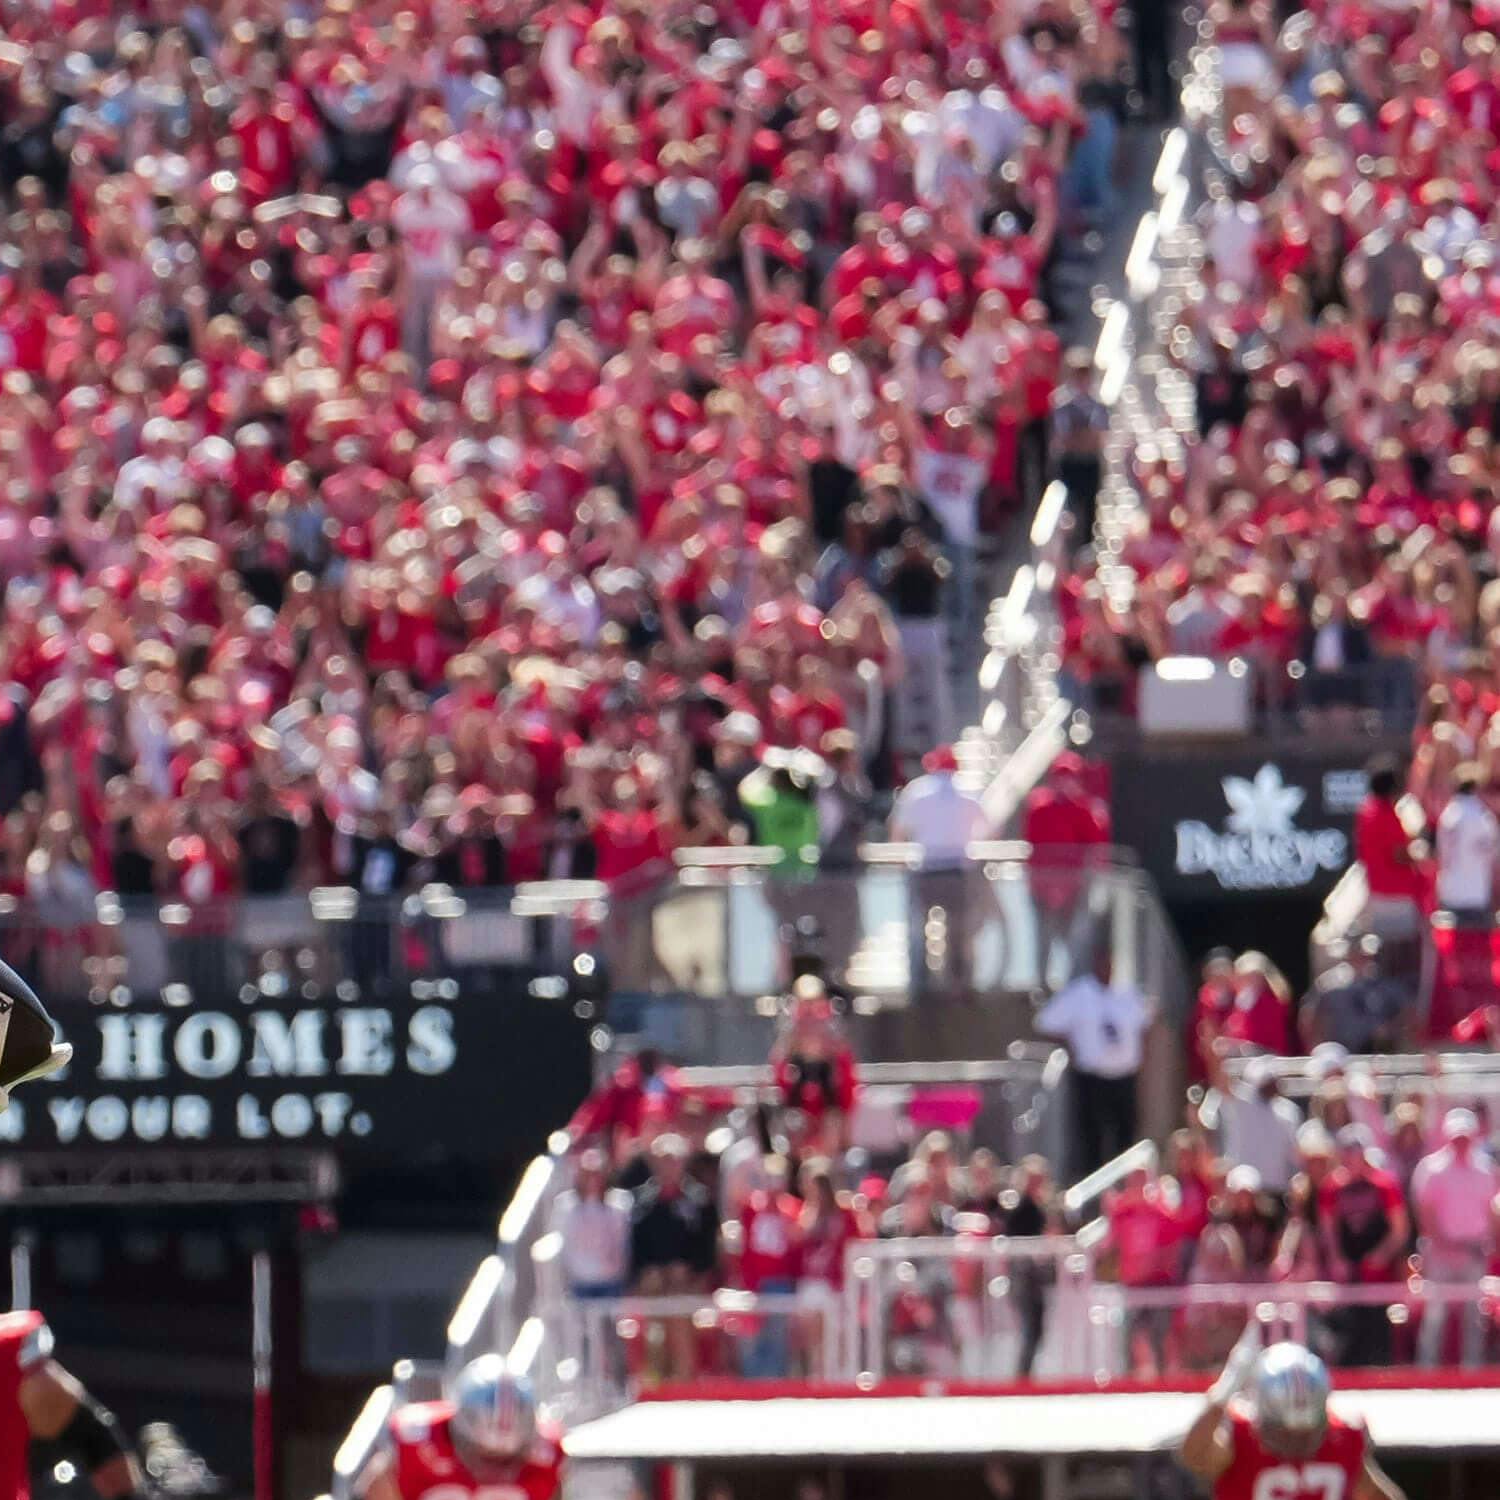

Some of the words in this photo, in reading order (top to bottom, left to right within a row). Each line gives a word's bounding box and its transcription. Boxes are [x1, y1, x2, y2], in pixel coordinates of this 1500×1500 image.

[98, 1005, 458, 1080] HOMES
[49, 1092, 212, 1142] YOUR
[236, 1091, 373, 1137] LOT.
